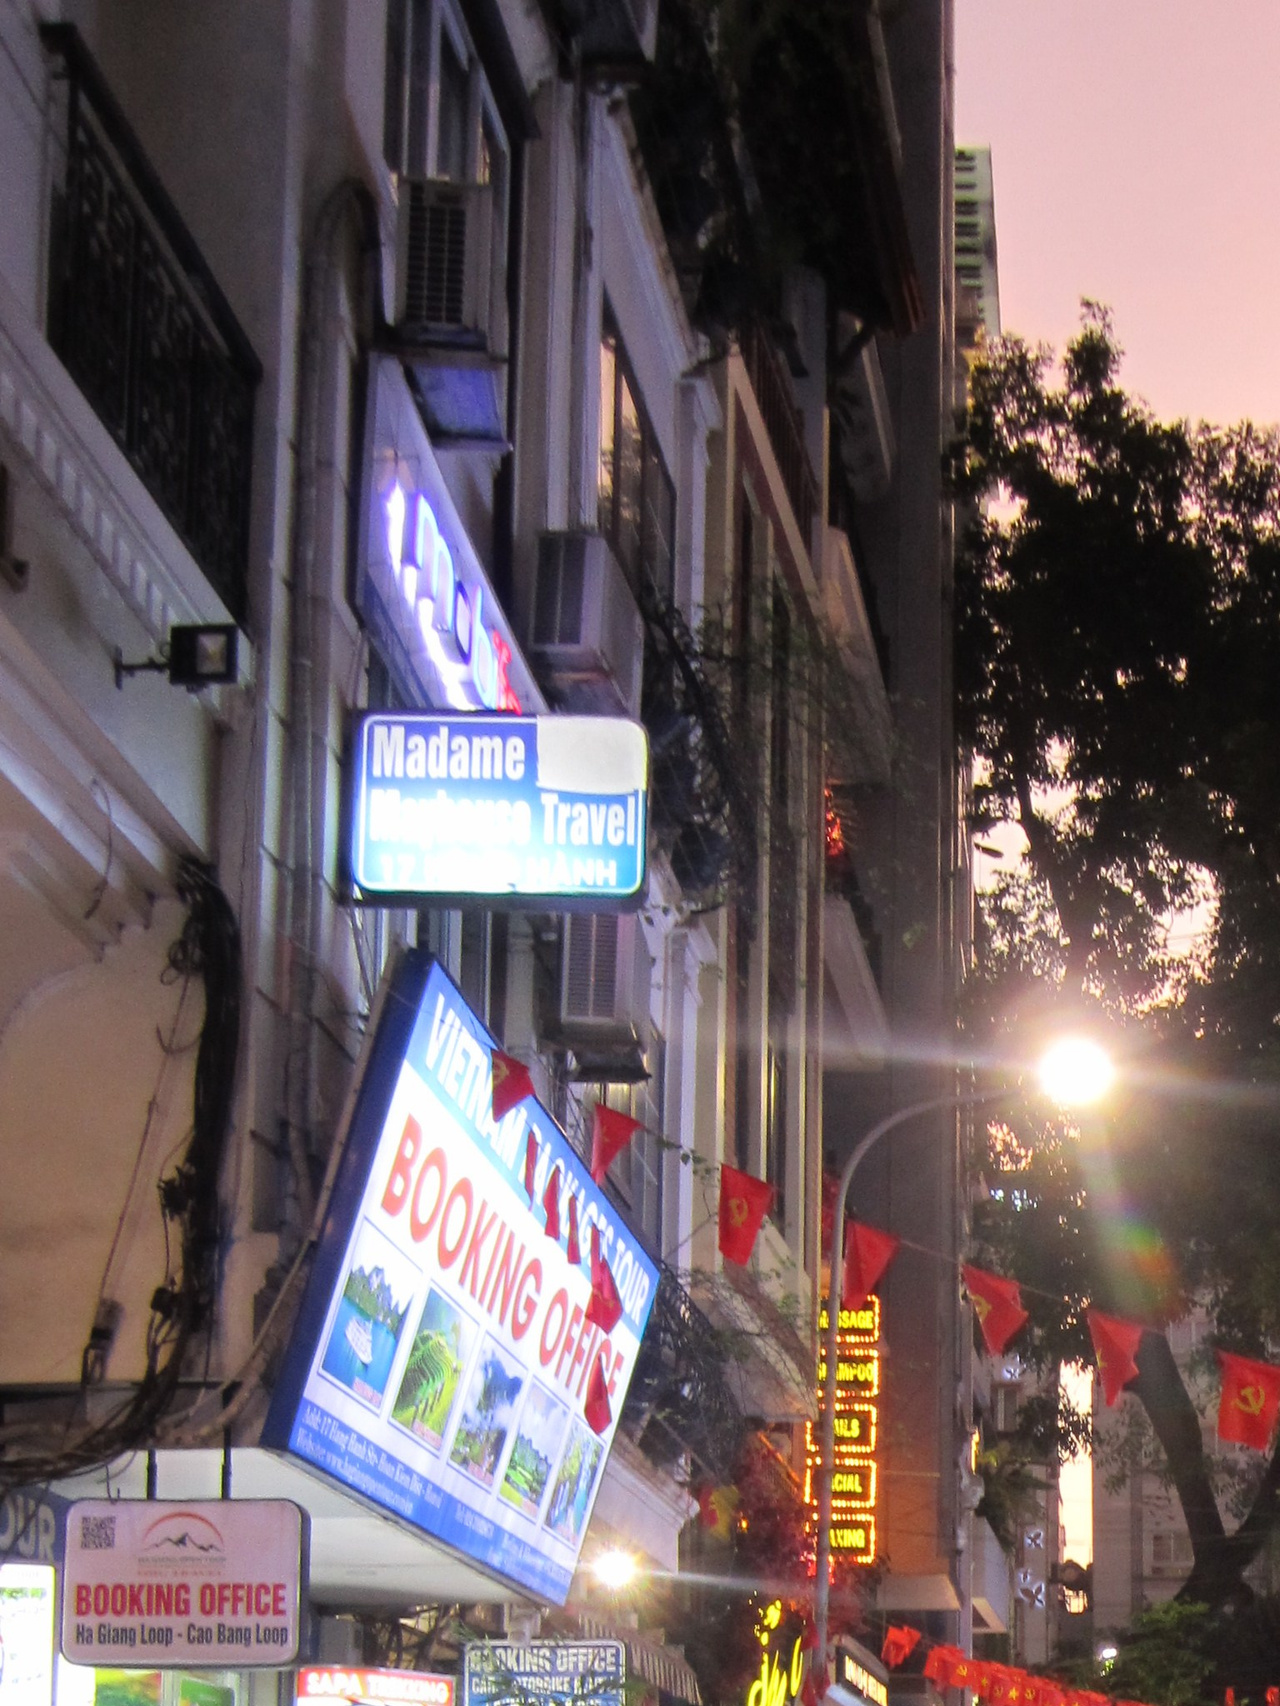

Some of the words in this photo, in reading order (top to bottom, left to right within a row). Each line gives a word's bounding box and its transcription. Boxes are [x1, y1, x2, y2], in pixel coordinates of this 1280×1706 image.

[372, 725, 525, 780] Madame
[541, 793, 635, 846] Travel
[381, 1112, 543, 1342] BOOKING
[614, 1235, 651, 1328] TOUR
[75, 1583, 190, 1616] BOOKING
[200, 1583, 286, 1616] OFFICE
[76, 1624, 93, 1644] Ha
[98, 1623, 136, 1646] Giang
[141, 1623, 173, 1646] Loop
[187, 1623, 212, 1645] Cao
[217, 1624, 251, 1647] Bang
[256, 1624, 288, 1647] Loop
[556, 1648, 617, 1673] OFFICE
[306, 1671, 364, 1697] SAPA
[367, 1674, 450, 1706] TREKKING
